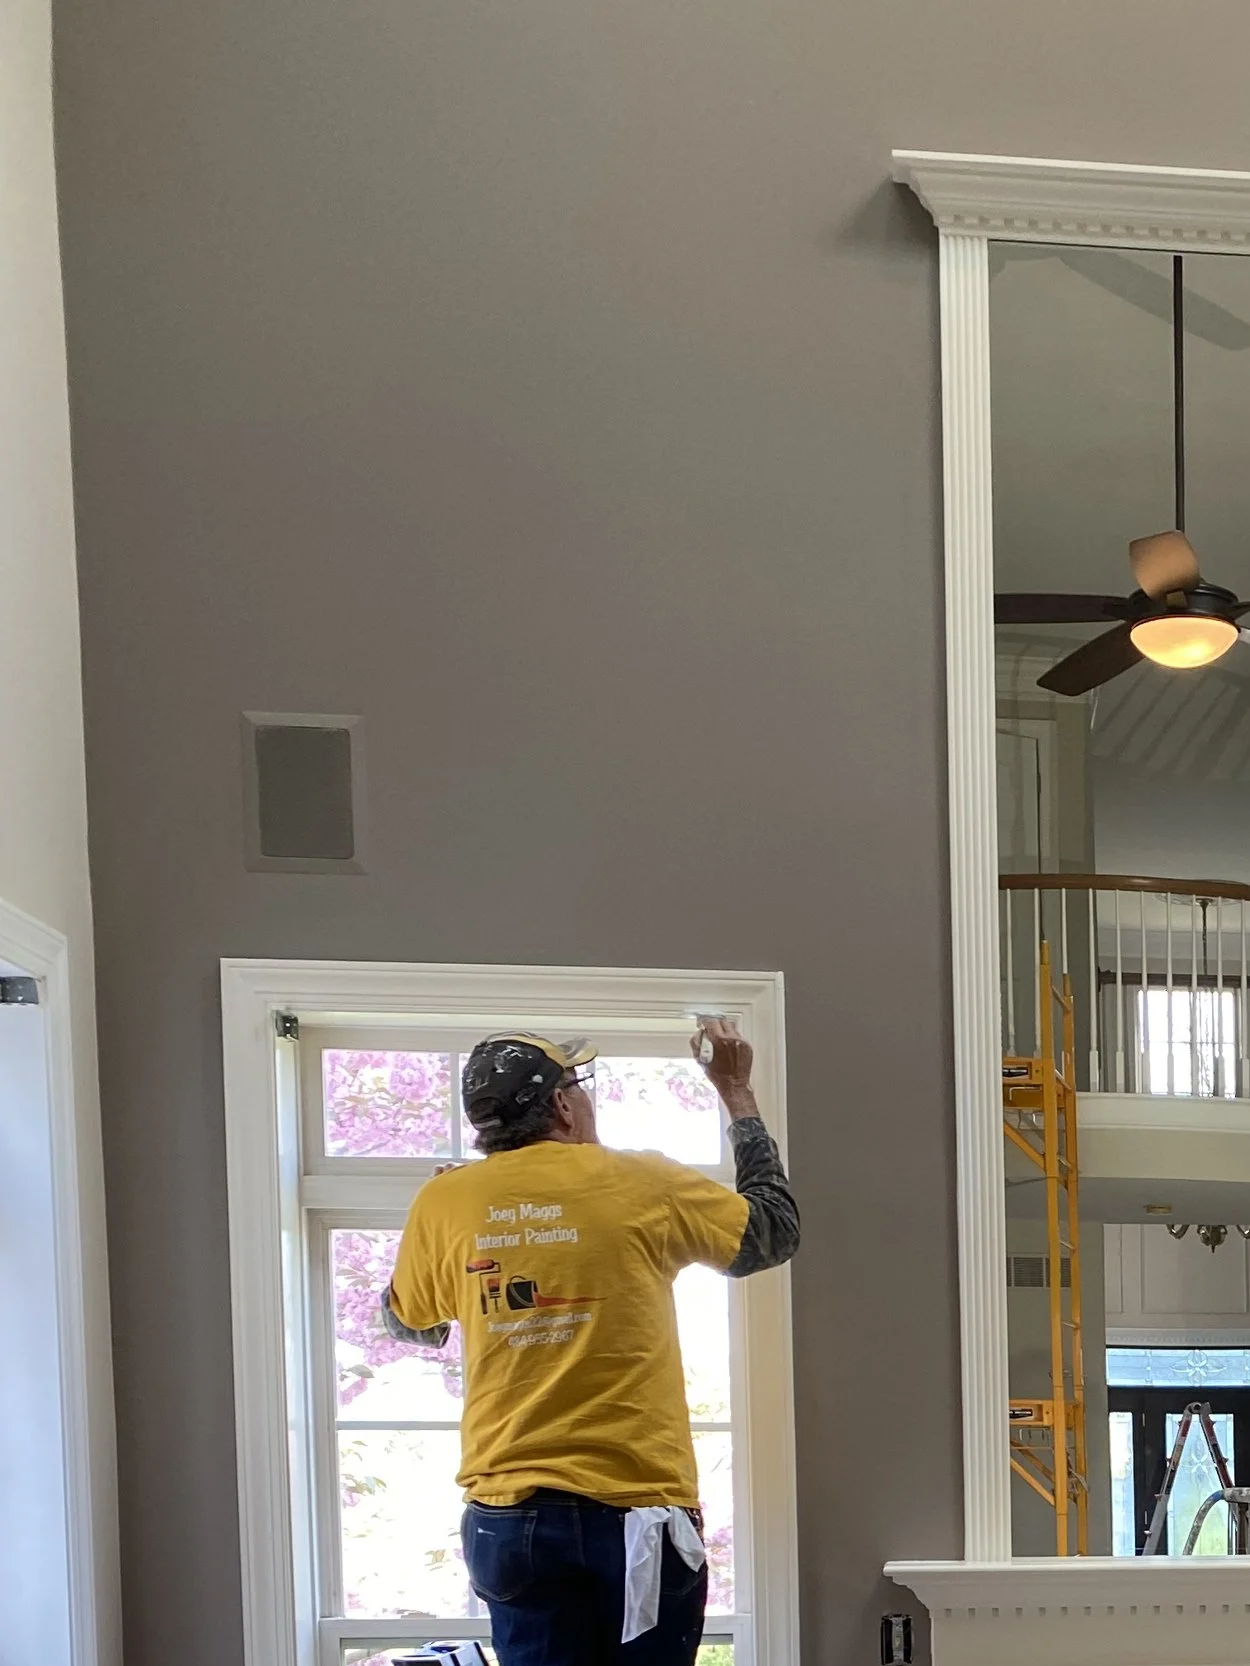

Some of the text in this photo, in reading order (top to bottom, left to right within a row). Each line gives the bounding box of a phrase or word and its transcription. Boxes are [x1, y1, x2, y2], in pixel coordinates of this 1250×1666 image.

[486, 1203, 562, 1224] Joey Maggs
[475, 1227, 578, 1250] Interior Painting
